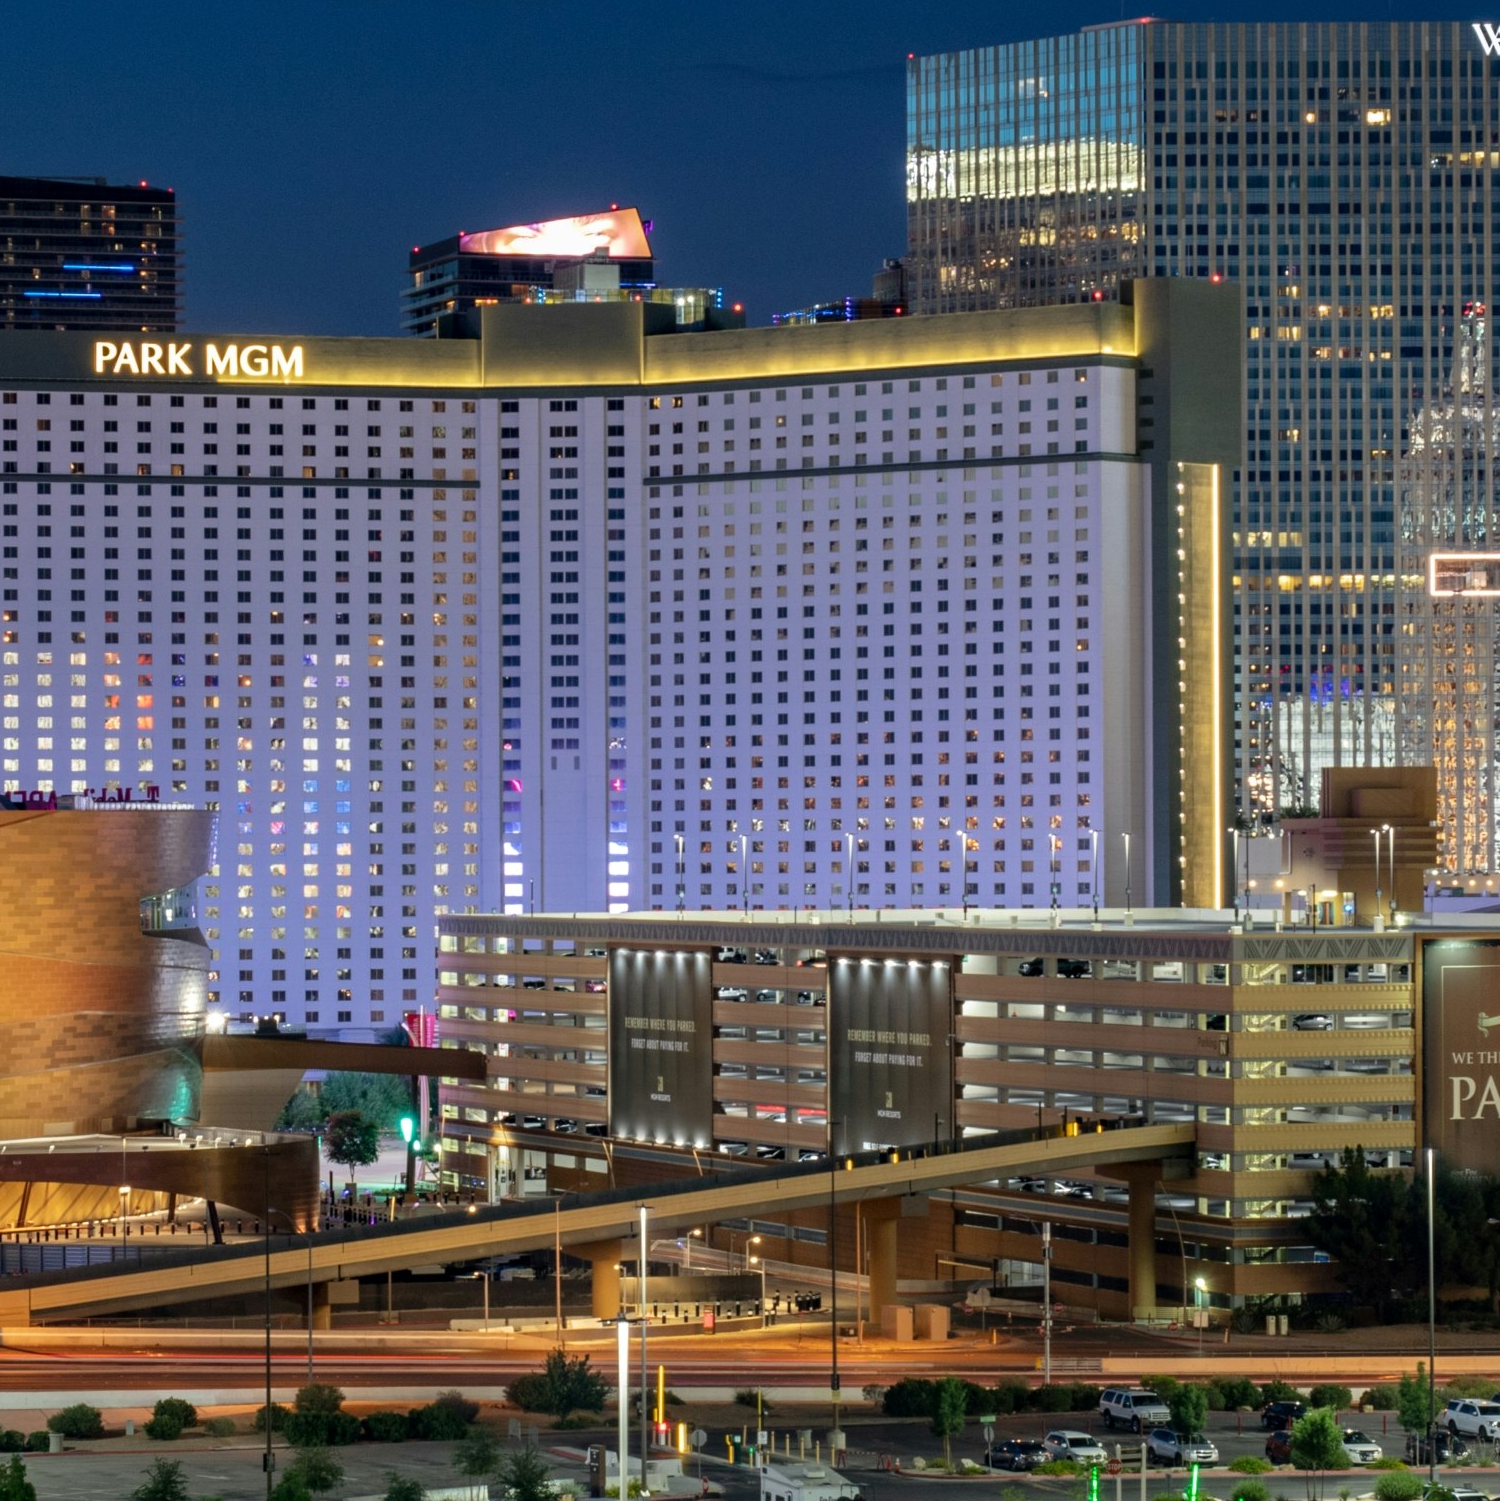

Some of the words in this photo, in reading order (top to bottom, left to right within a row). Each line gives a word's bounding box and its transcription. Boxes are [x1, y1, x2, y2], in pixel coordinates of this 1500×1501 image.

[95, 342, 193, 375] PARK
[206, 343, 303, 377] MGM
[625, 1017, 649, 1029] REMEMBER
[649, 1018, 666, 1030] WHERE
[666, 1019, 676, 1031] YOU
[677, 1020, 697, 1033] PARKED.
[631, 1038, 646, 1049] FORGET
[646, 1039, 659, 1050] ABOUT
[660, 1040, 674, 1051] PAYING
[675, 1041, 683, 1052] FOR
[847, 1029, 876, 1042] REMEMBER
[877, 1030, 896, 1044] WHERE
[896, 1032, 908, 1044] YOU
[909, 1033, 933, 1046] PARKED.
[855, 1051, 872, 1063] FORGET
[873, 1053, 888, 1064] ABOUT
[889, 1054, 905, 1066] PAYING
[906, 1055, 915, 1066] FOR
[916, 1056, 924, 1067] IT.
[1452, 1052, 1474, 1065] WE
